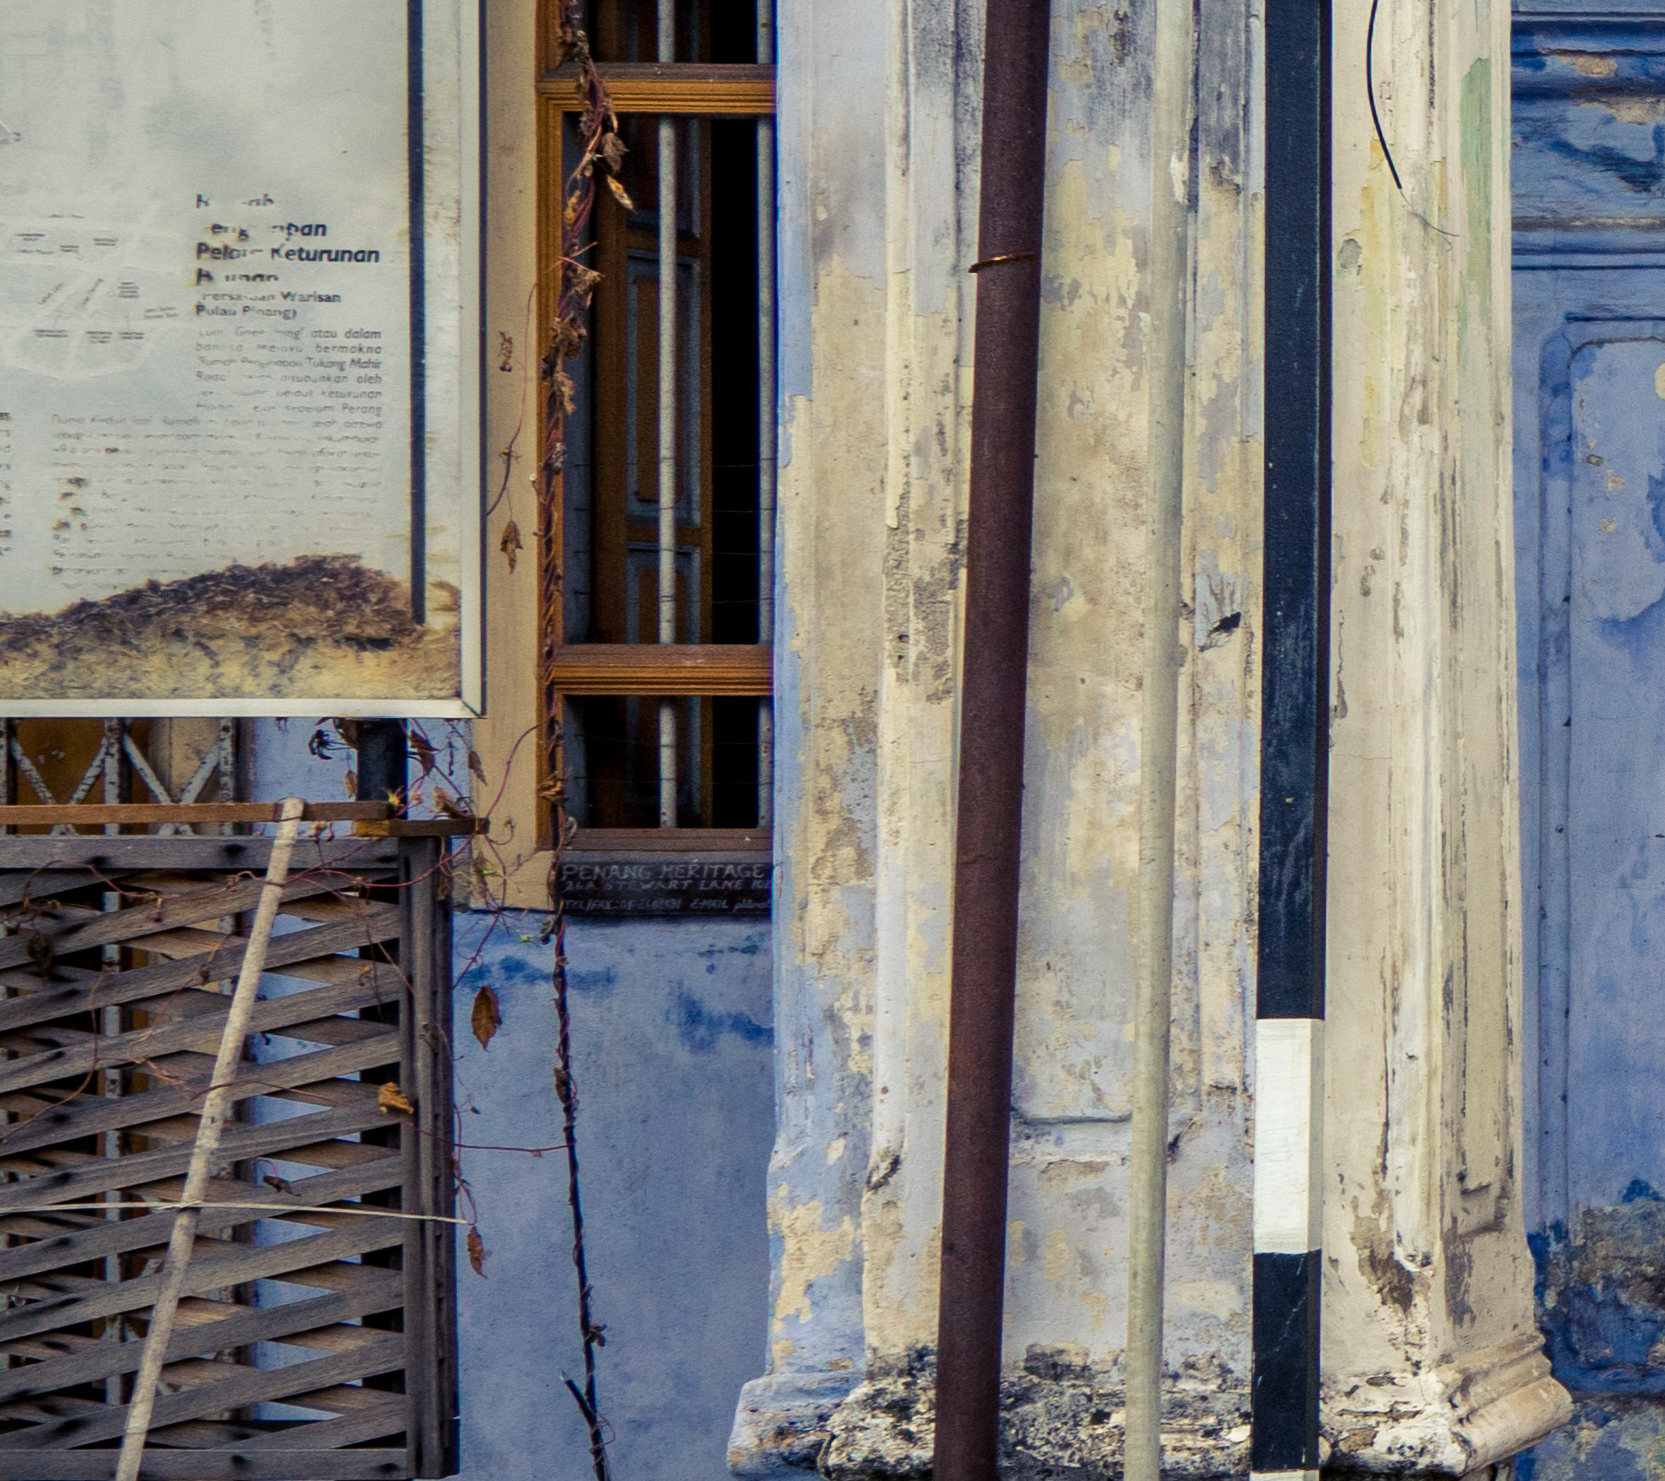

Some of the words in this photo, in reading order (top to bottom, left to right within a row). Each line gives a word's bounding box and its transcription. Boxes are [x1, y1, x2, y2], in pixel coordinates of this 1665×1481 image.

[270, 244, 380, 263] Keturunan
[280, 291, 342, 303] Warisan
[310, 330, 338, 339] atau
[344, 328, 382, 340] dalam
[356, 373, 383, 385] oleh
[561, 864, 654, 881] PENANG
[658, 864, 765, 880] HERITAGE
[602, 879, 694, 891] STEWART
